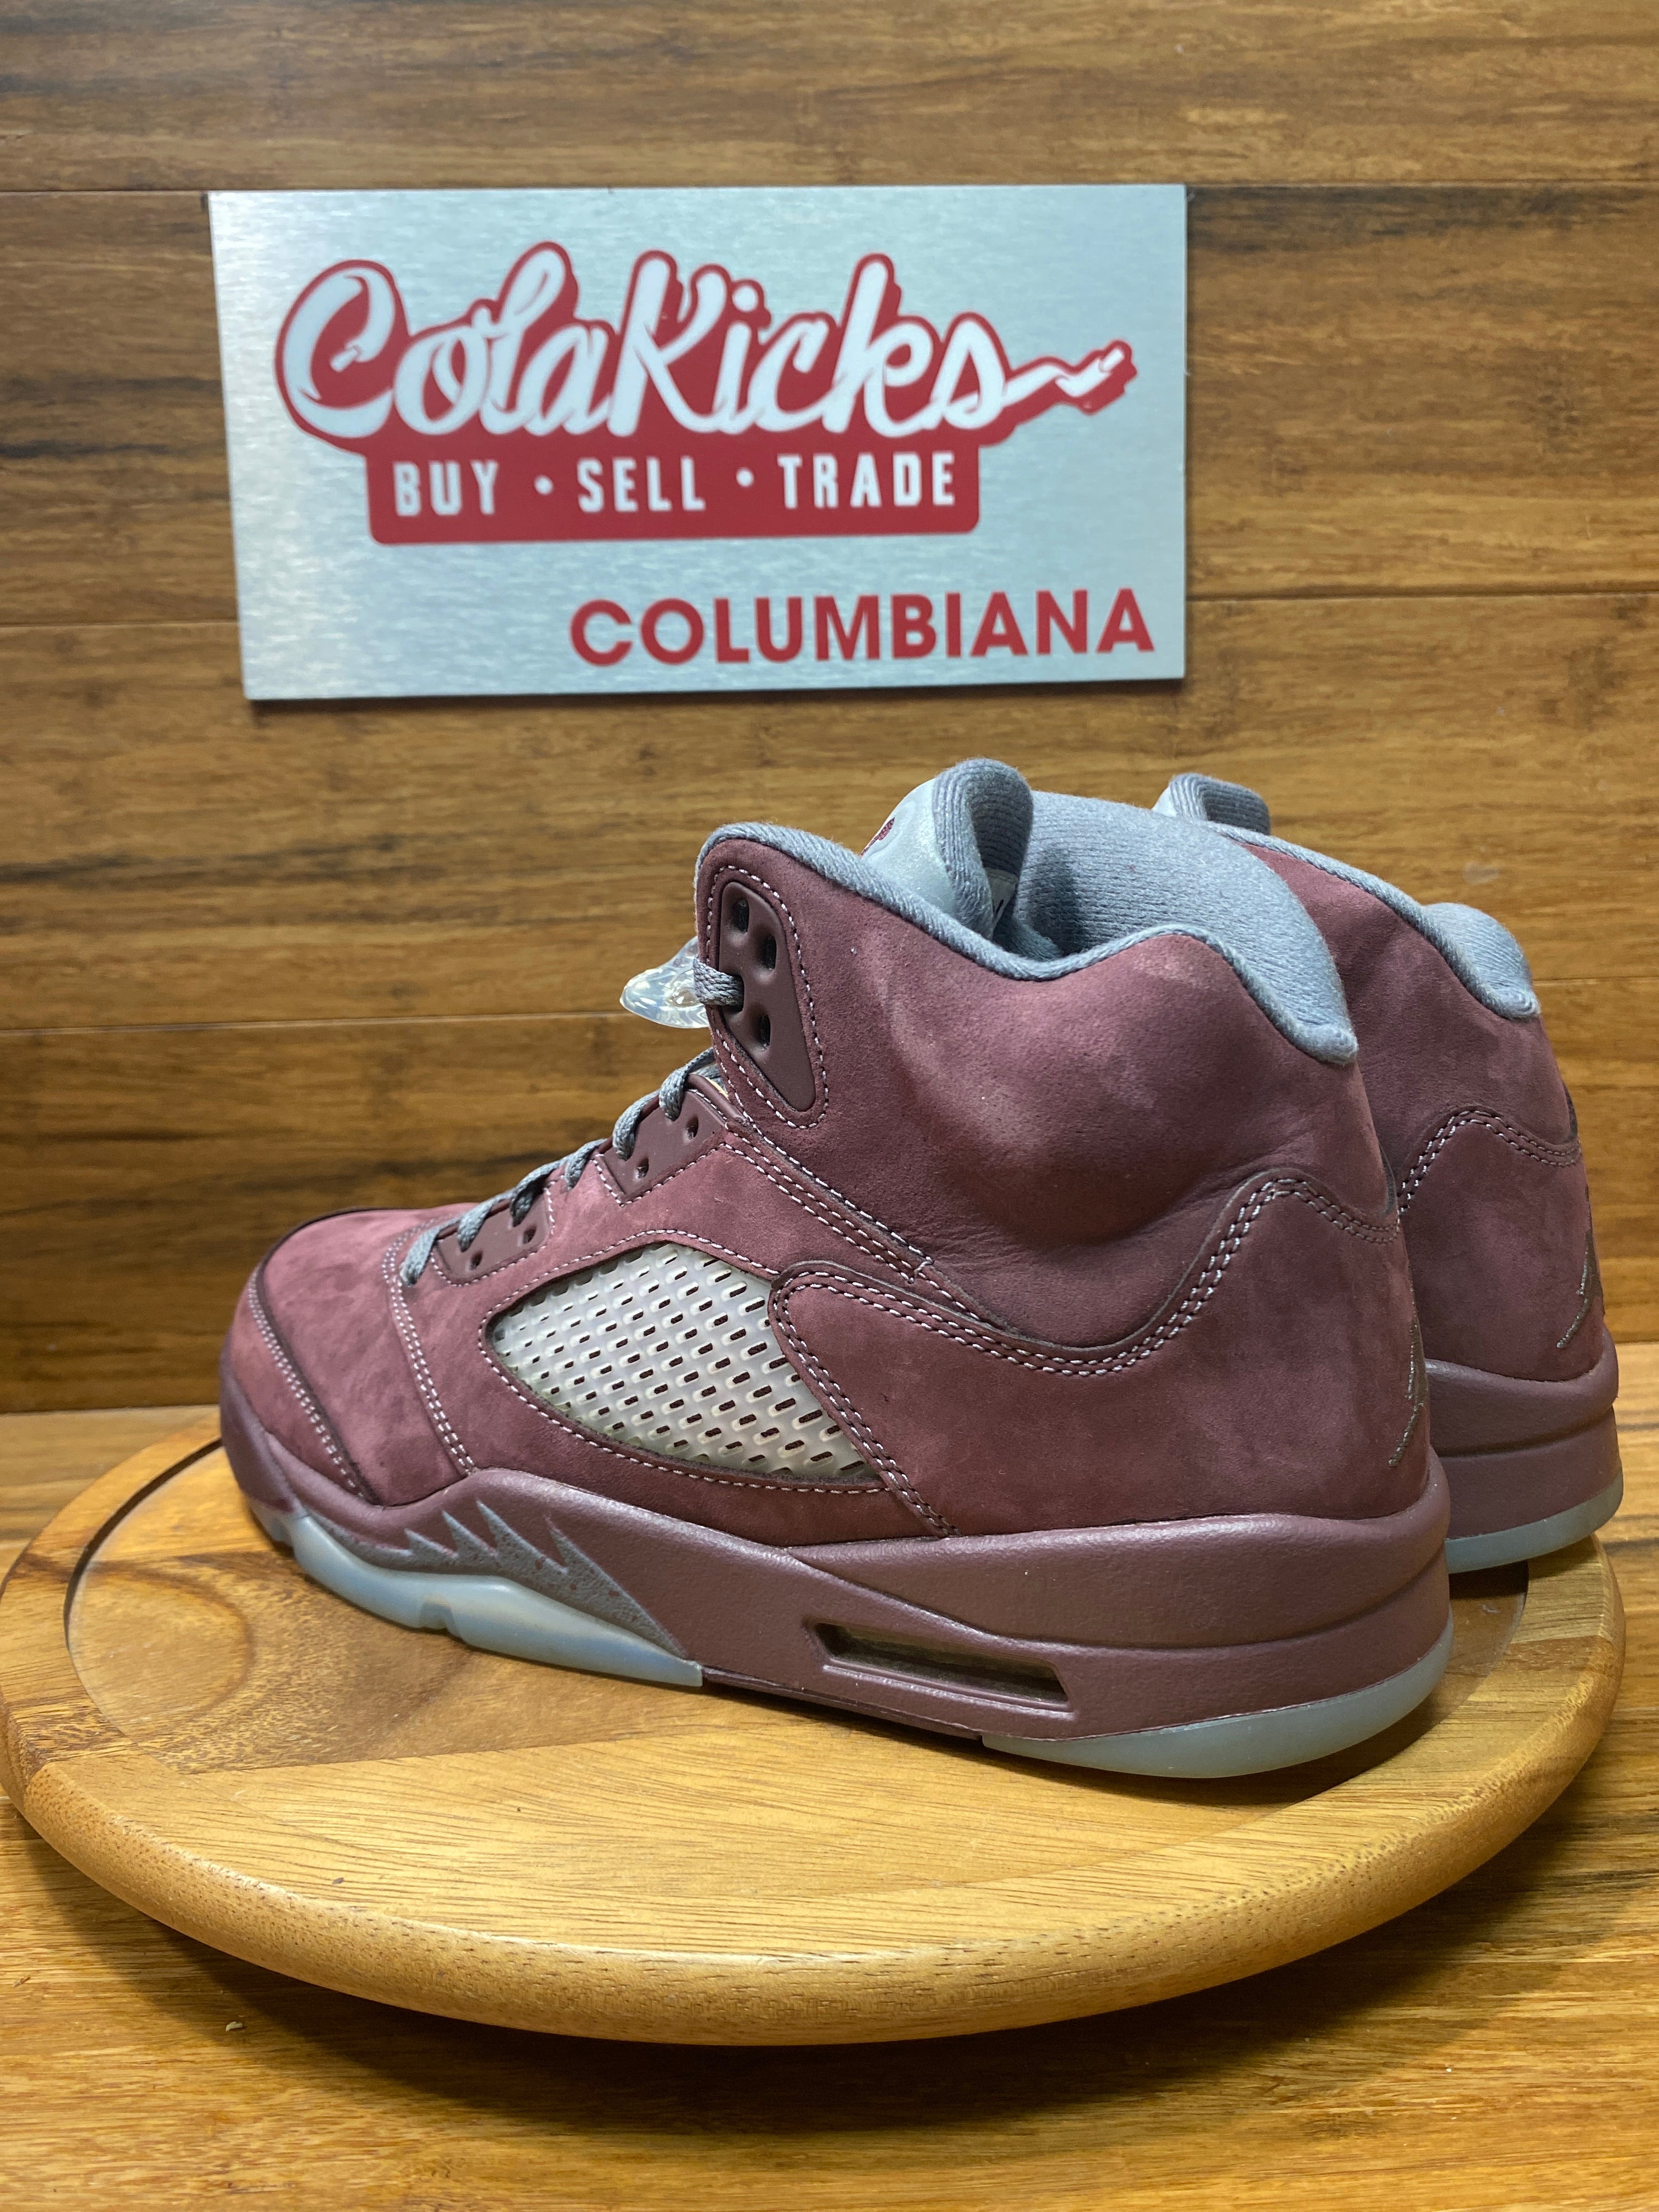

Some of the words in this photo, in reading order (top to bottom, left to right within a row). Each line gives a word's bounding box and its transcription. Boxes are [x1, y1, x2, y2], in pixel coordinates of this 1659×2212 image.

[279, 245, 1135, 440] ColaKicks
[393, 460, 499, 517] BUY
[577, 456, 706, 513] SELL
[777, 451, 956, 509] TRADE
[571, 588, 1154, 665] COLUMBIANA
